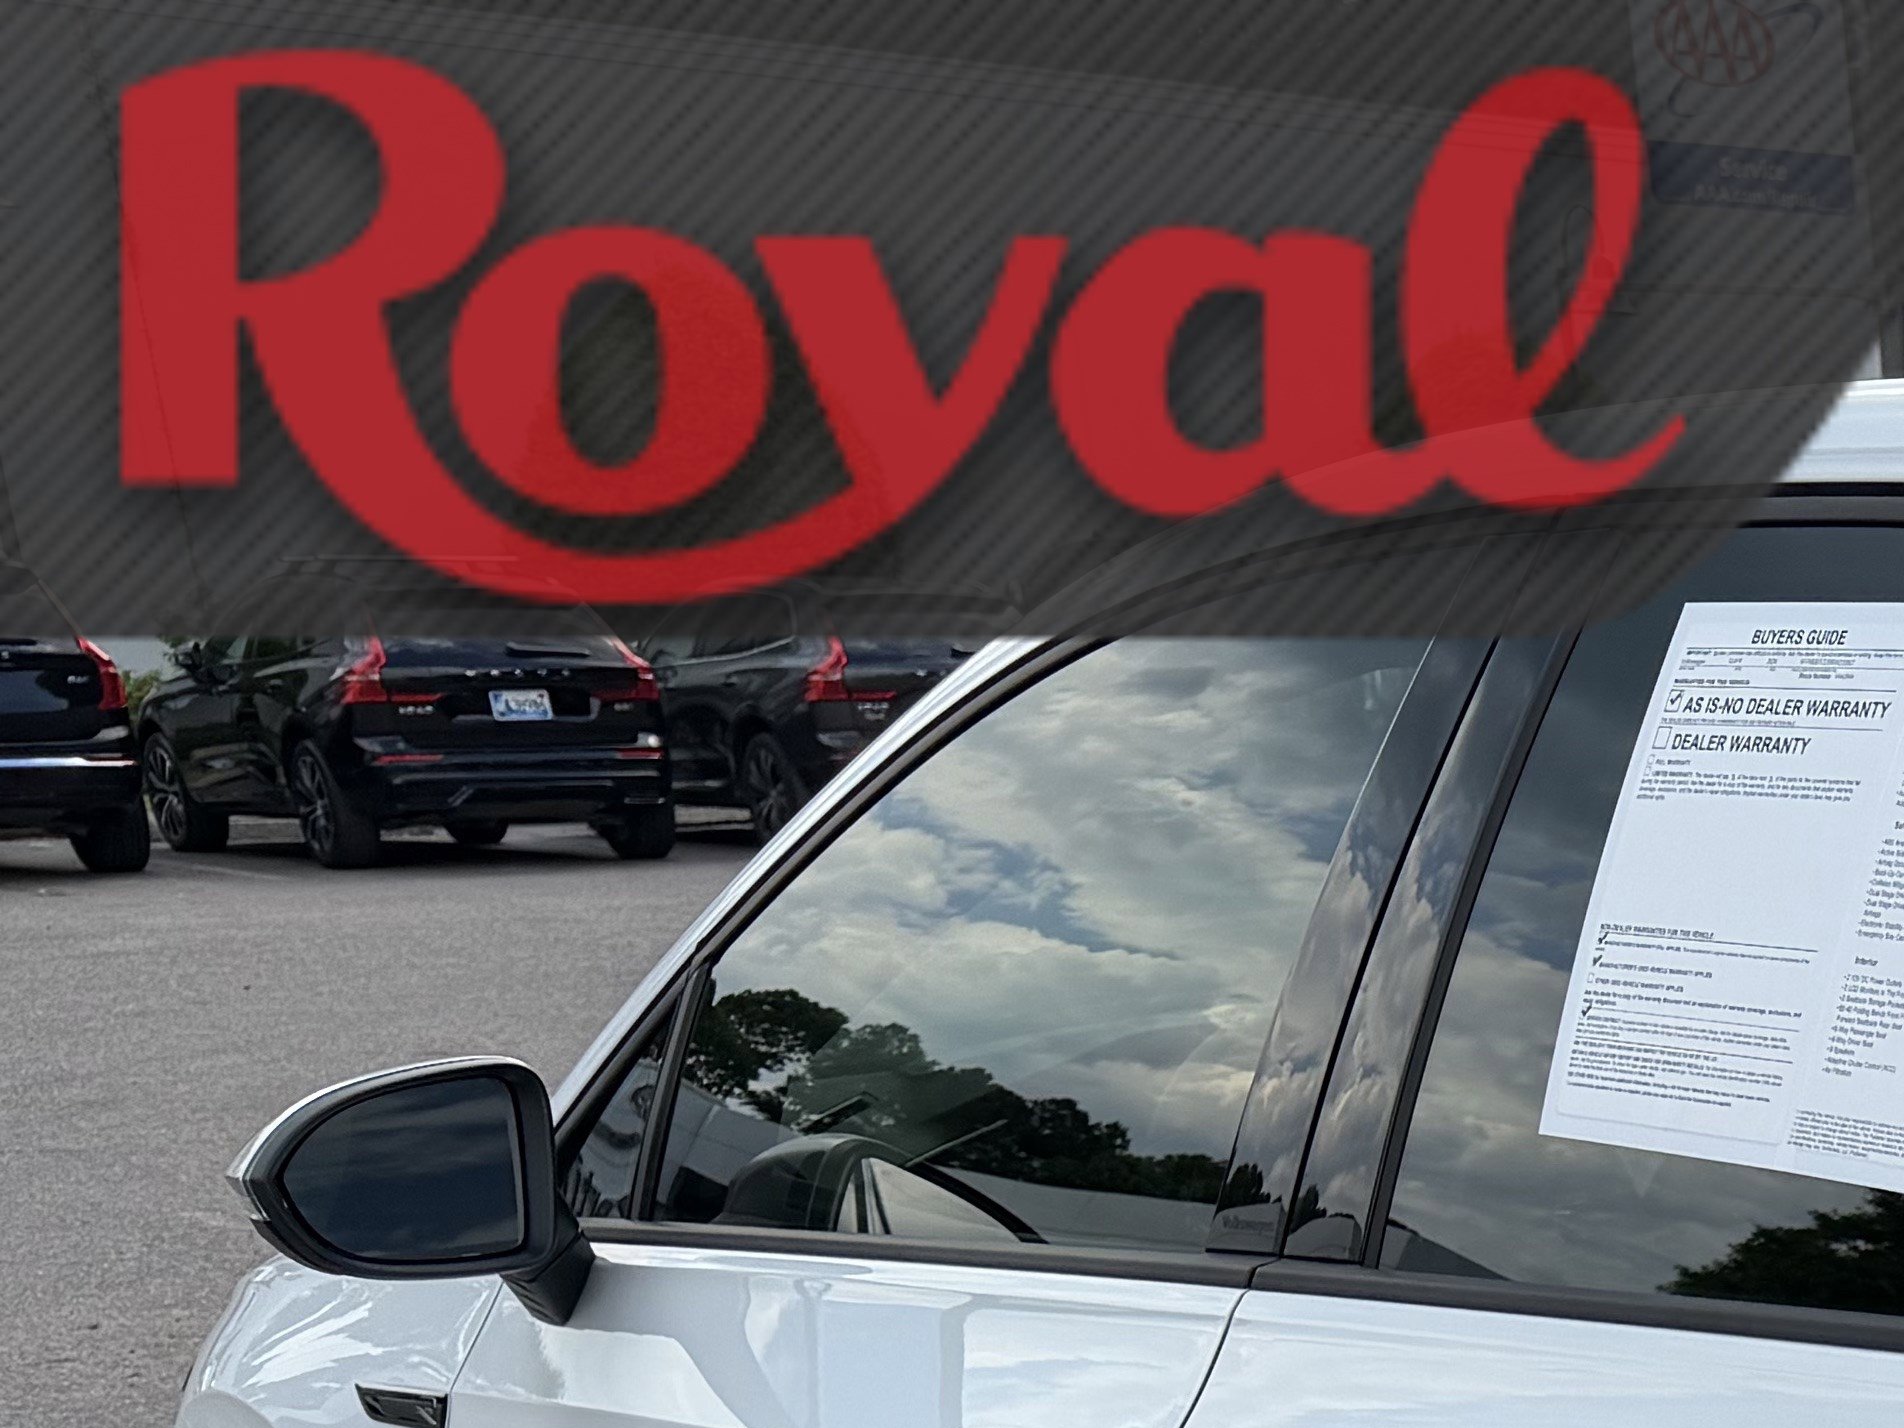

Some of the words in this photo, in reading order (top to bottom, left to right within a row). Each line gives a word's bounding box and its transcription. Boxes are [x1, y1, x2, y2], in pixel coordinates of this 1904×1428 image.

[1750, 628, 1805, 645] BUYERS
[1805, 628, 1848, 645] GUIDE
[1681, 696, 1704, 713] AS
[1704, 696, 1744, 714] IS-NO
[1744, 697, 1804, 716] DEALER
[1805, 699, 1892, 719] WARRANTY
[1670, 732, 1727, 751] DEALER
[1728, 734, 1812, 755] WARRANTY
